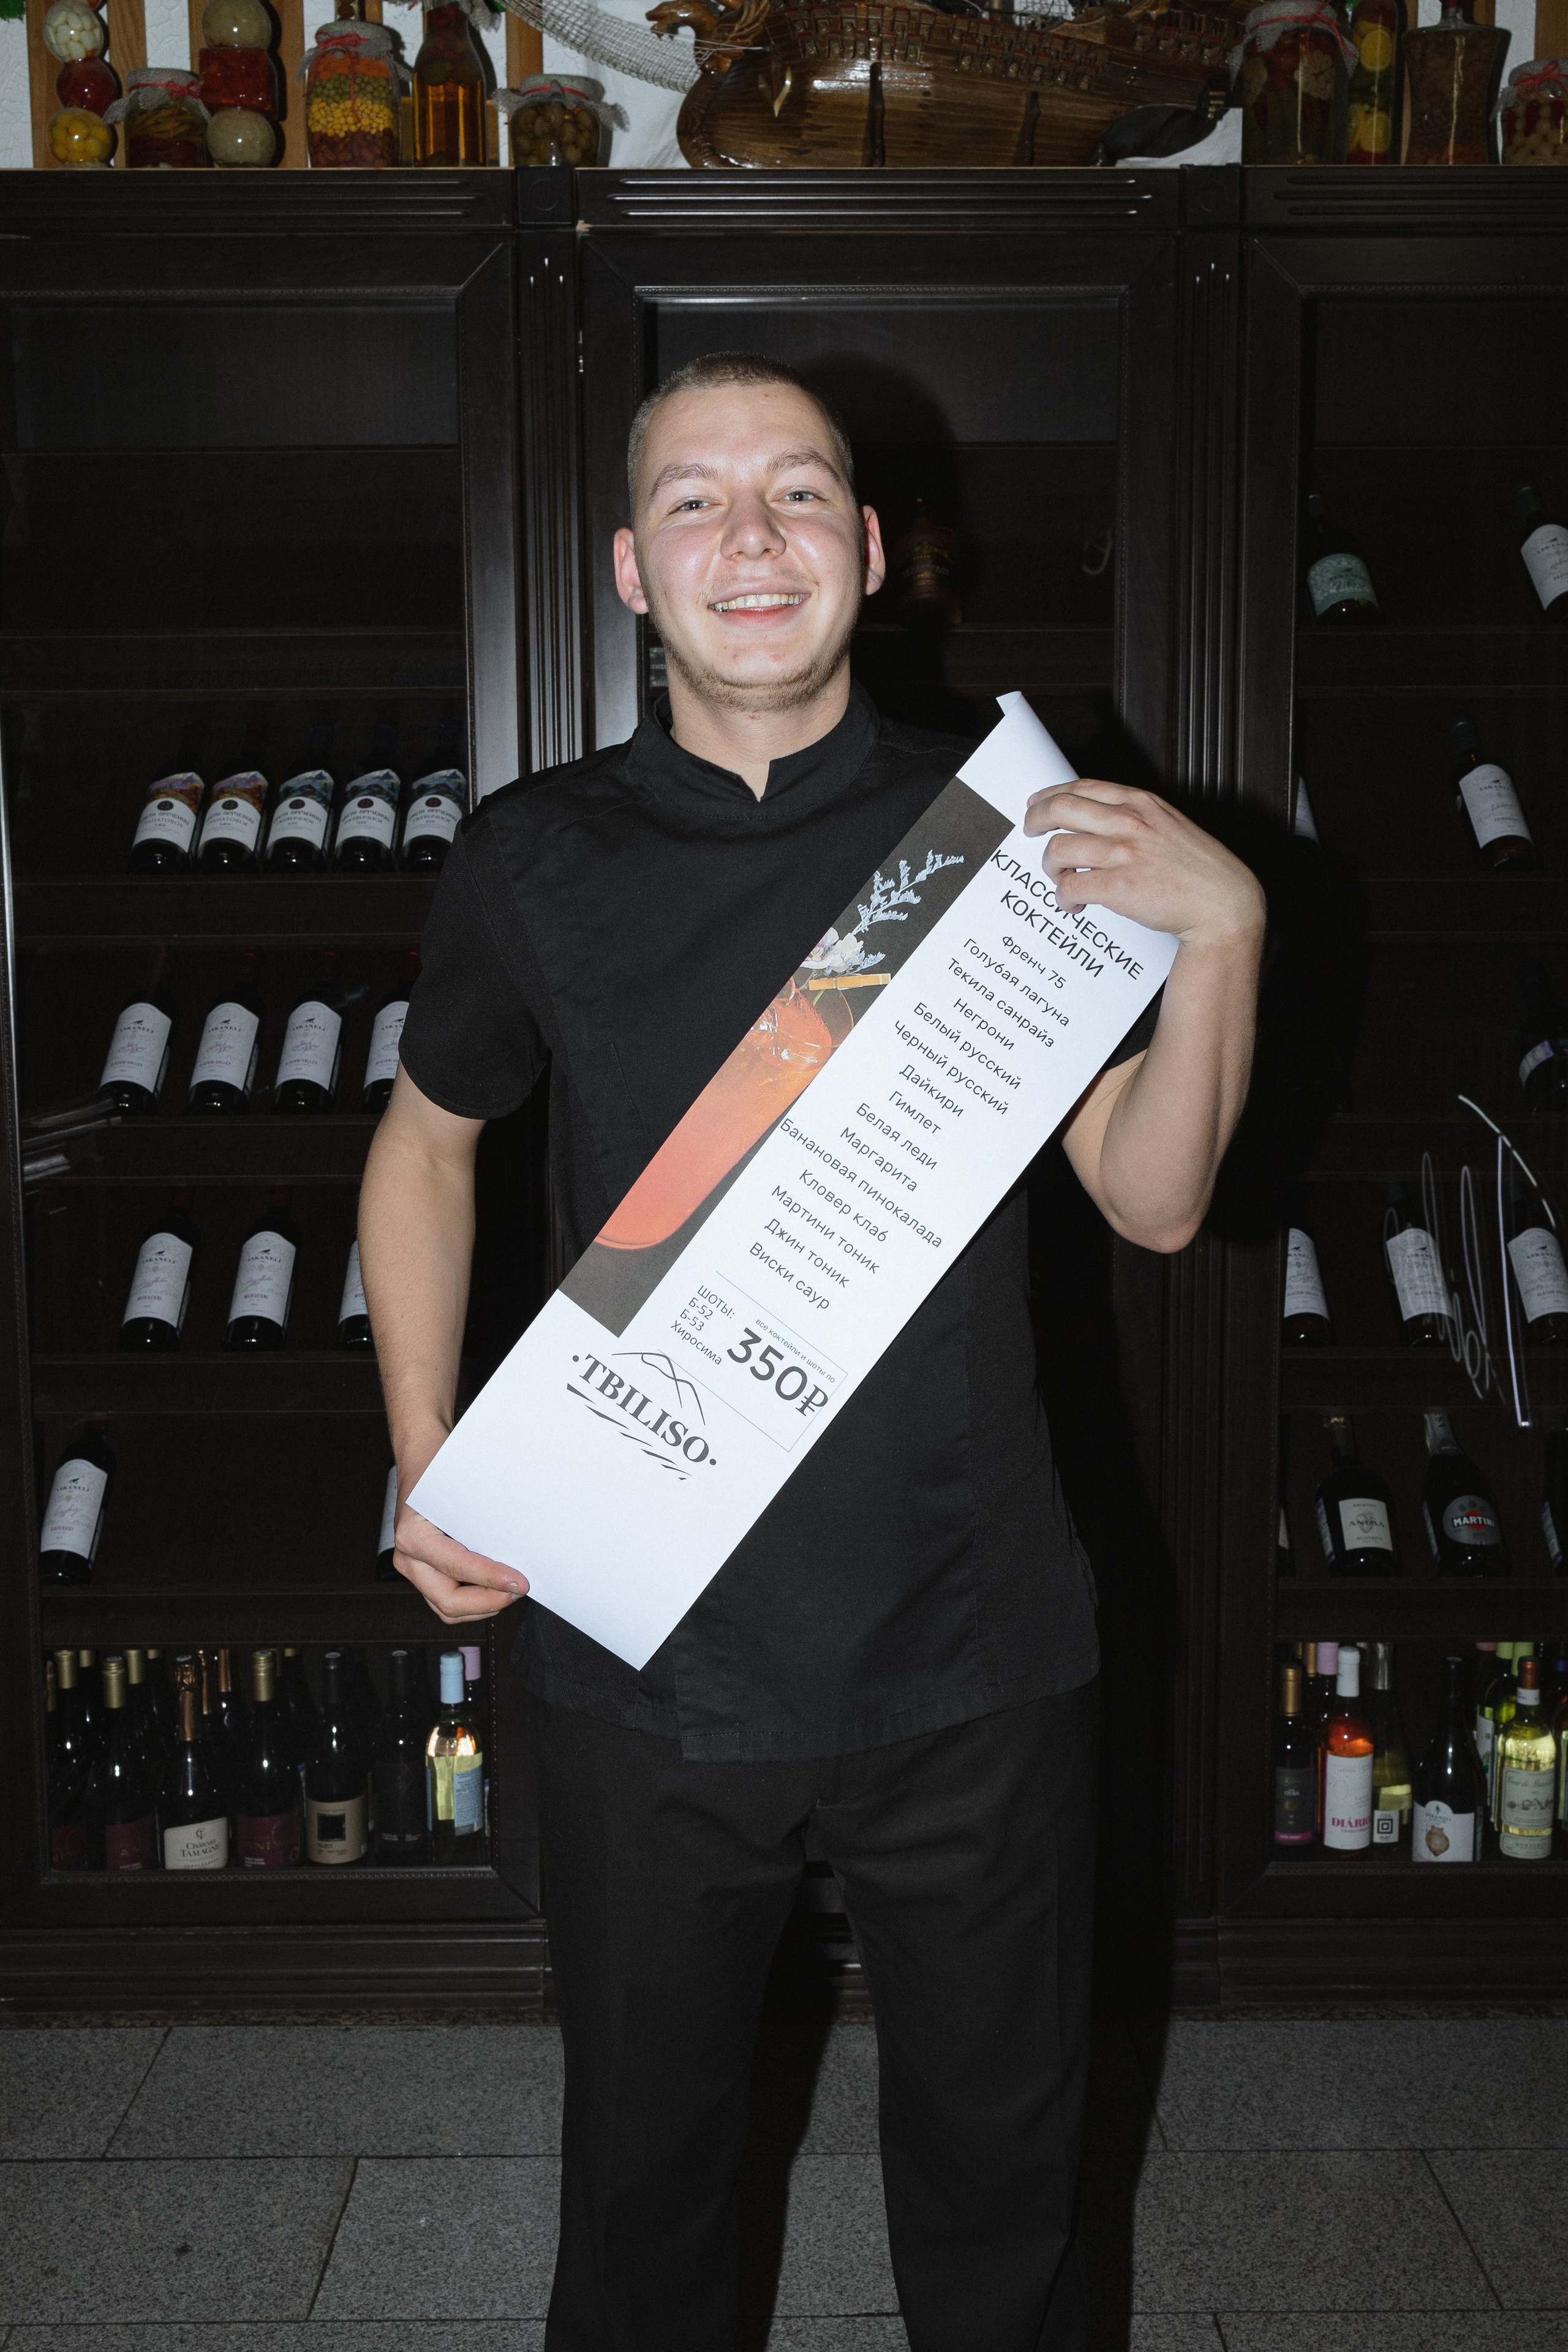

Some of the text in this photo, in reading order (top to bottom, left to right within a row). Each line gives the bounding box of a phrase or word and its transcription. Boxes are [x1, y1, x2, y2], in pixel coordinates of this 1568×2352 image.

[1000, 890, 1104, 978] КОКТЕЙЛИ
[1003, 937, 1066, 989] Френч 75
[948, 958, 1054, 1047] Текила санрайз
[963, 938, 1069, 1027] Голубая лагуна
[914, 1002, 1021, 1089] Белый русский
[954, 998, 1014, 1050] Негрони
[895, 1020, 1008, 1115] Черный русский
[899, 1065, 963, 1117] Дайкири
[856, 1103, 937, 1169] Белая леди
[889, 1091, 941, 1133] Гимлет
[780, 1118, 941, 1248] Банановая пинокалада
[840, 1127, 917, 1191] Маргарита
[772, 1185, 880, 1274] Мартини тоник
[799, 1169, 888, 1242] Кловер клаб
[750, 1242, 829, 1309] Виски саур
[764, 1218, 850, 1287] Джин тоник
[680, 1309, 704, 1331] Б-53
[689, 1297, 713, 1320] Б-52
[698, 1286, 734, 1319] ШОТЫ:
[671, 1320, 722, 1365] Хиросима
[756, 1319, 768, 1330] все
[769, 1329, 801, 1356] коктейли
[807, 1359, 826, 1376] шоты
